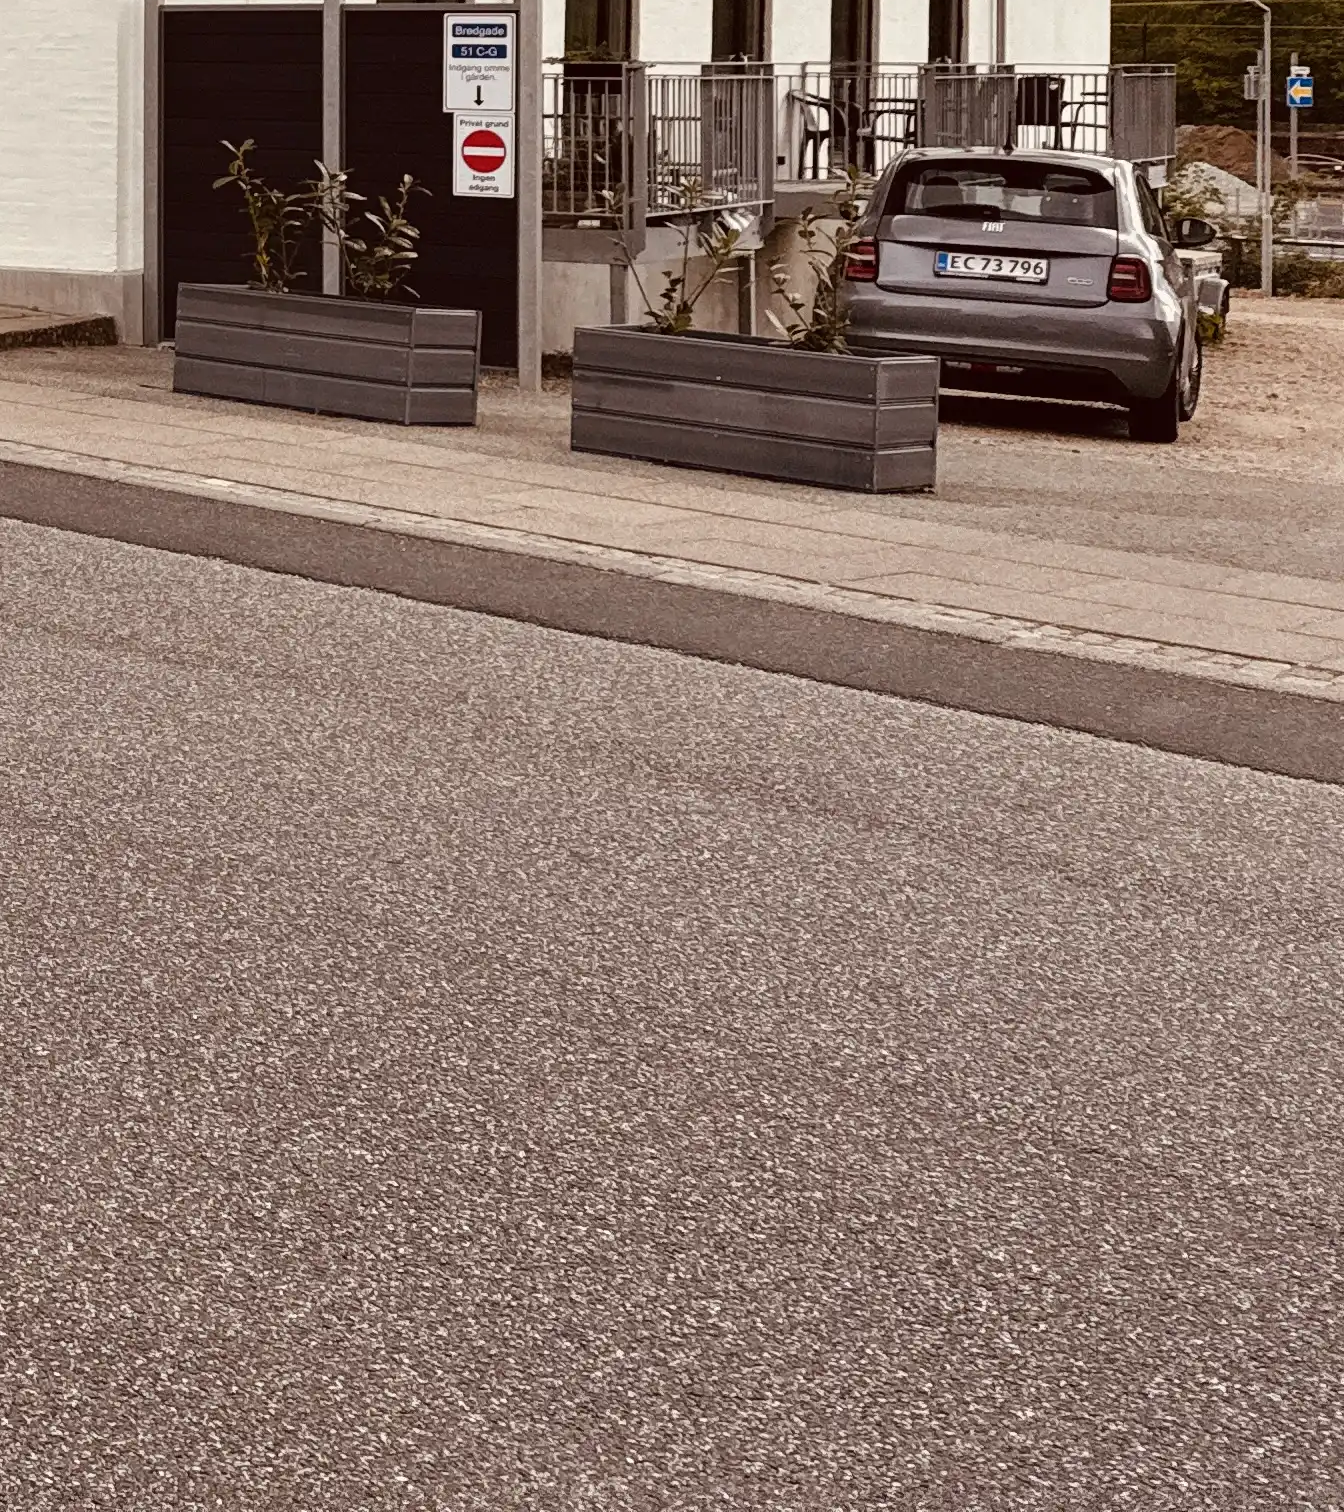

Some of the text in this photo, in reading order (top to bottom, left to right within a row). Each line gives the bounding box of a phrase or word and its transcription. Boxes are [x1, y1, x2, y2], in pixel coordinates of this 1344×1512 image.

[455, 25, 505, 38] Bredgade
[460, 46, 498, 57] 51 C-G
[459, 119, 510, 129] Privat grund
[950, 255, 1044, 276] EC 73 796
